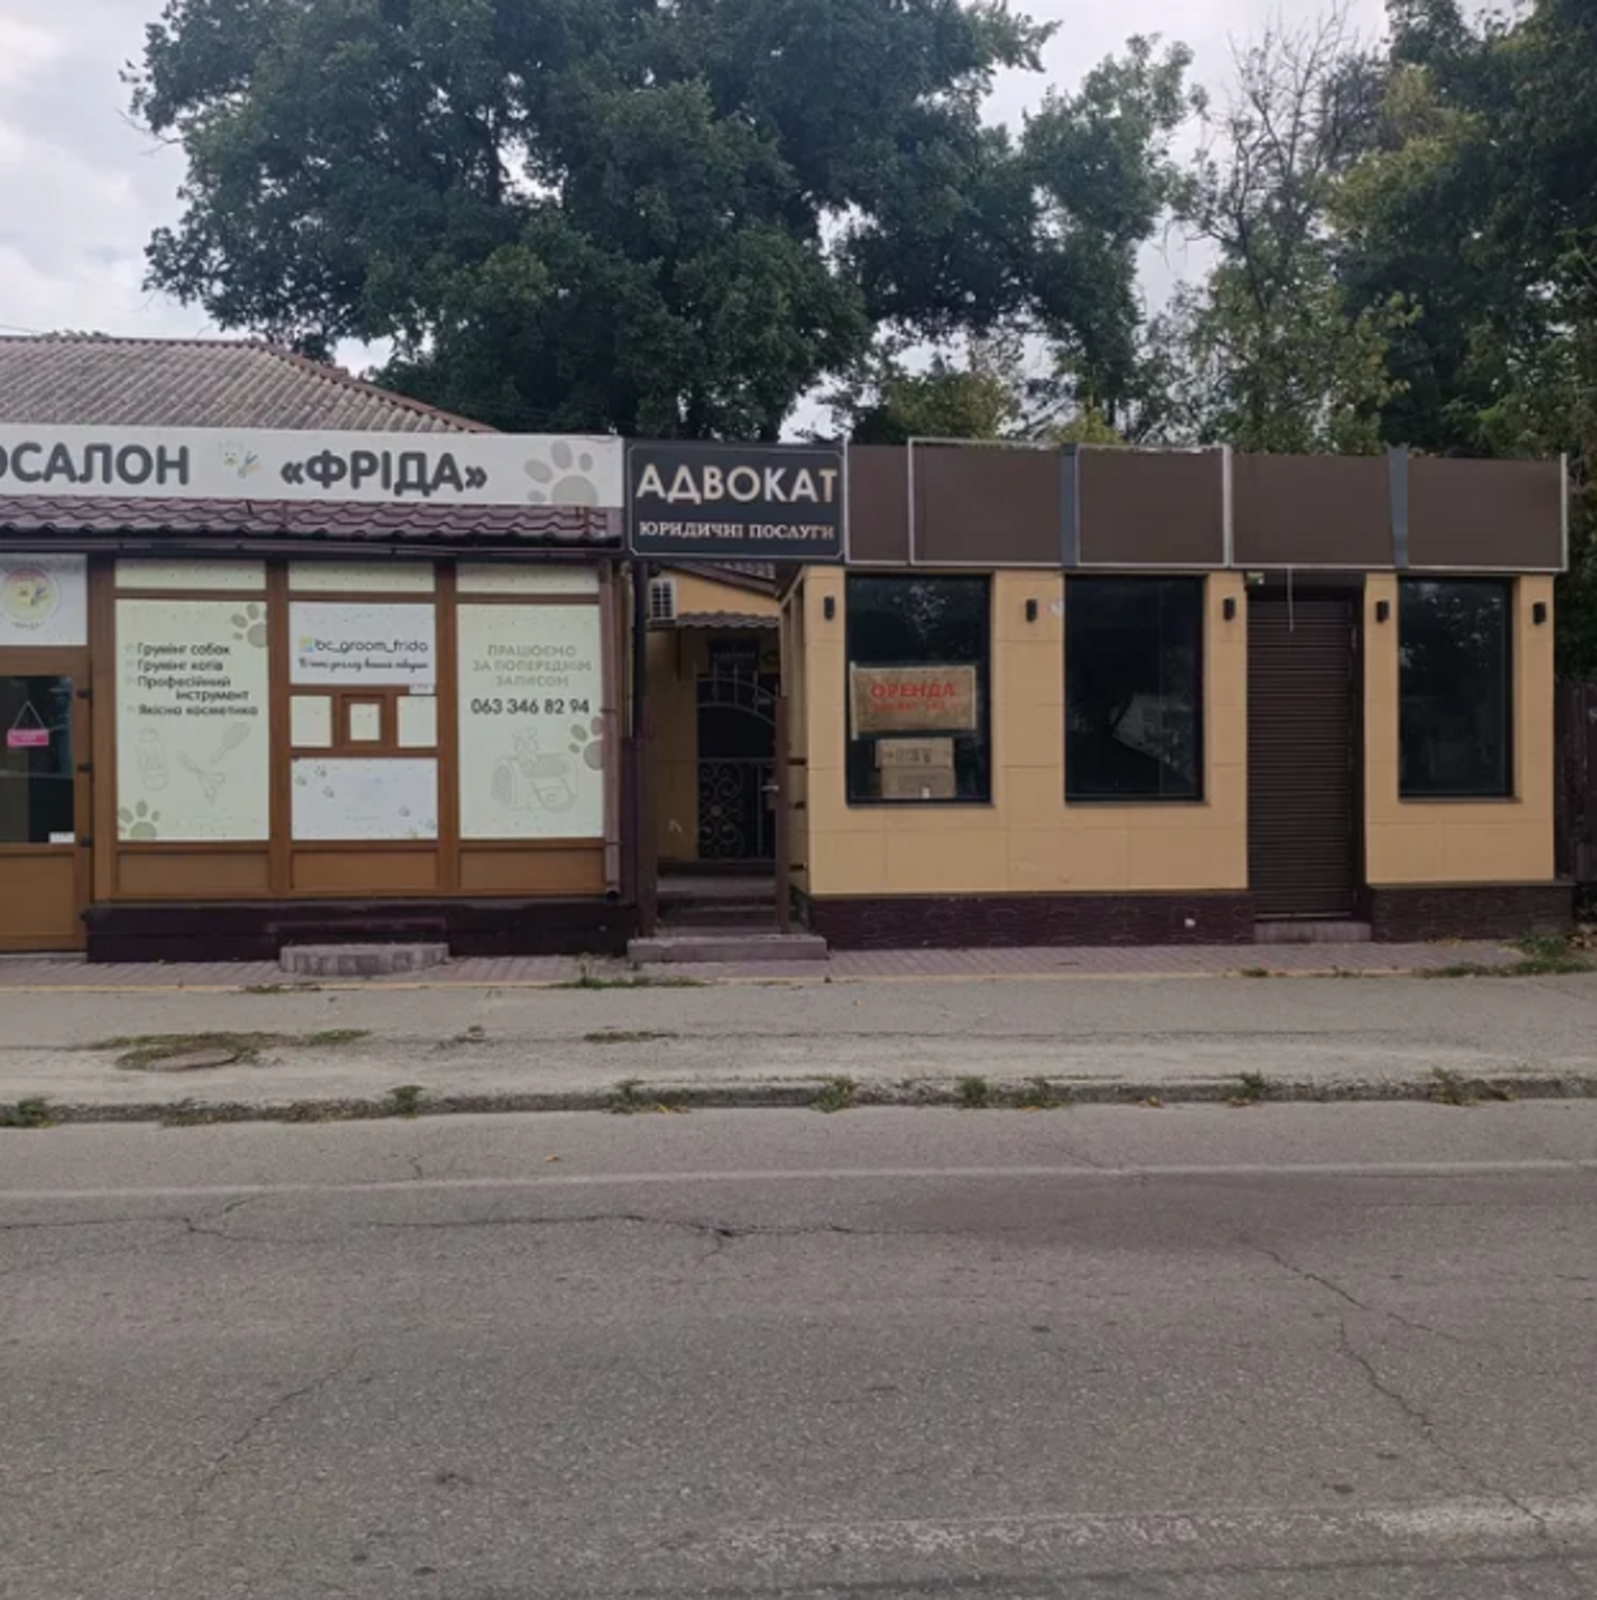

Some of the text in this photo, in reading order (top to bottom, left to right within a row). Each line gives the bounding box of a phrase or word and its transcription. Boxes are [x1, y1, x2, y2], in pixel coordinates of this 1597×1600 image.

[0, 441, 488, 498] САЛОН «ФРІДА»
[635, 462, 839, 505] АДВОКАТ
[638, 521, 836, 541] ЮРИДИЧНІ ПОСЛУГИ
[190, 642, 231, 656] собак
[190, 659, 224, 672] котів
[472, 660, 493, 672] ЗА
[137, 675, 232, 690] Професійний
[495, 675, 570, 688] ЗАПИСОМ
[175, 689, 249, 703] інструмент
[869, 681, 956, 699] ОРЕНДА
[185, 705, 259, 717] косметика
[470, 698, 590, 715] 063 346 82 94
